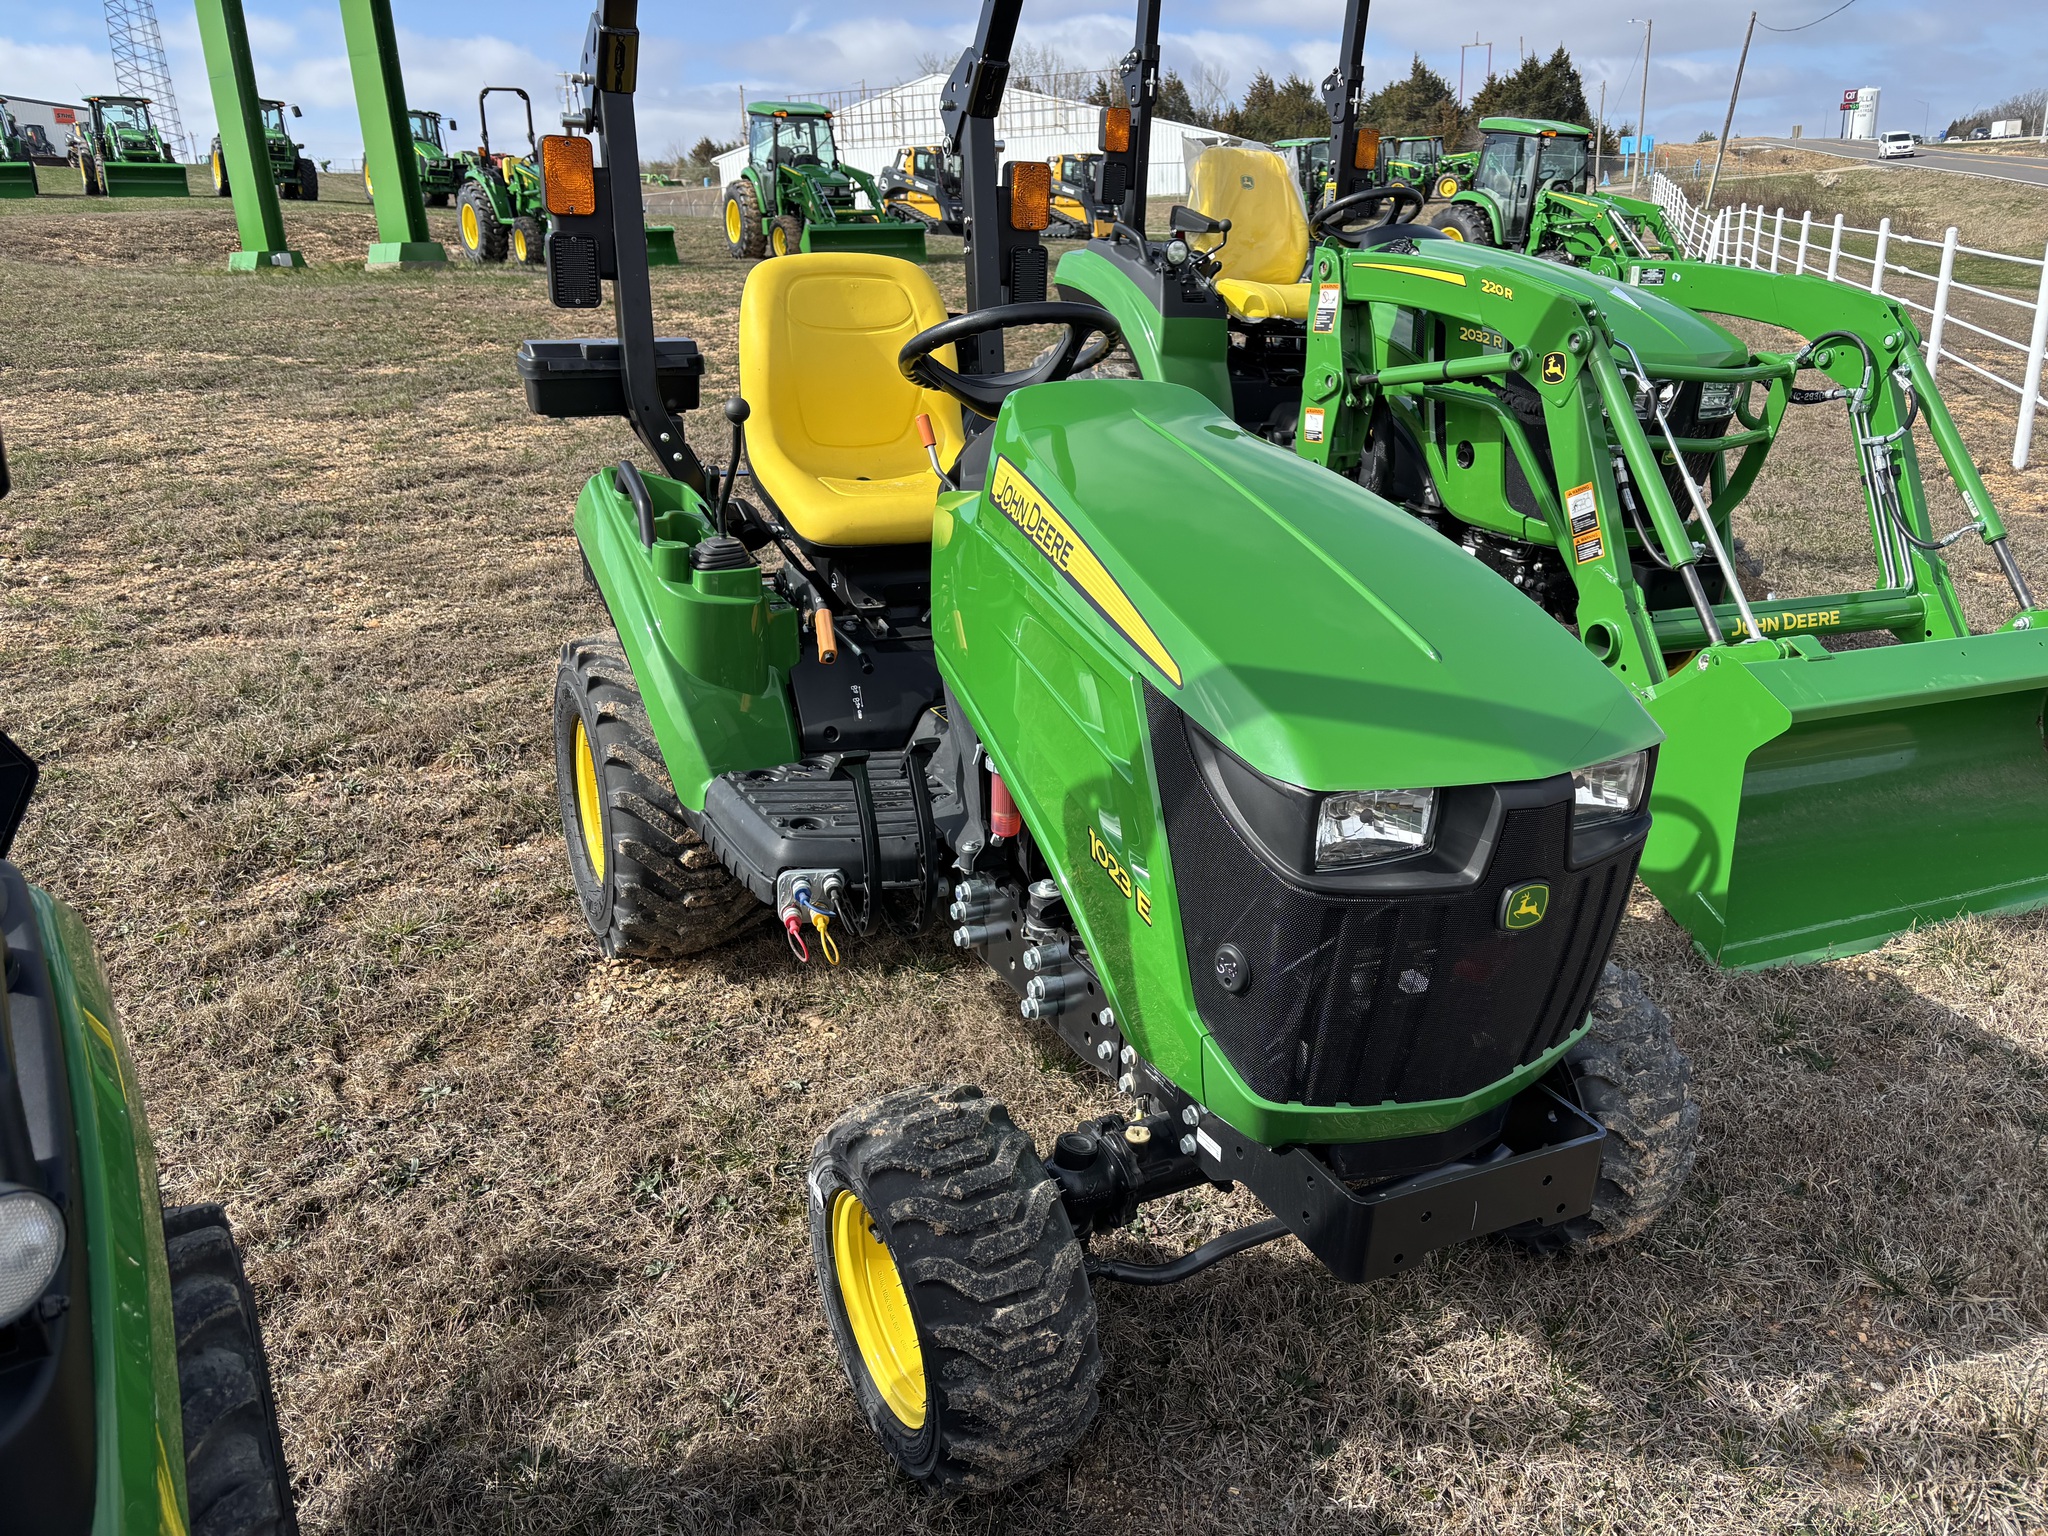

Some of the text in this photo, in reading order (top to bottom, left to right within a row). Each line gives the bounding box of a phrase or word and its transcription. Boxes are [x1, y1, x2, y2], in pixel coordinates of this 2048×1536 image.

[1846, 91, 1857, 100] QT
[1459, 326, 1503, 349] 2032 R
[996, 475, 1075, 569] JOHN DEERE
[1781, 610, 1841, 630] DEERE
[1087, 825, 1152, 928] 1023 E
